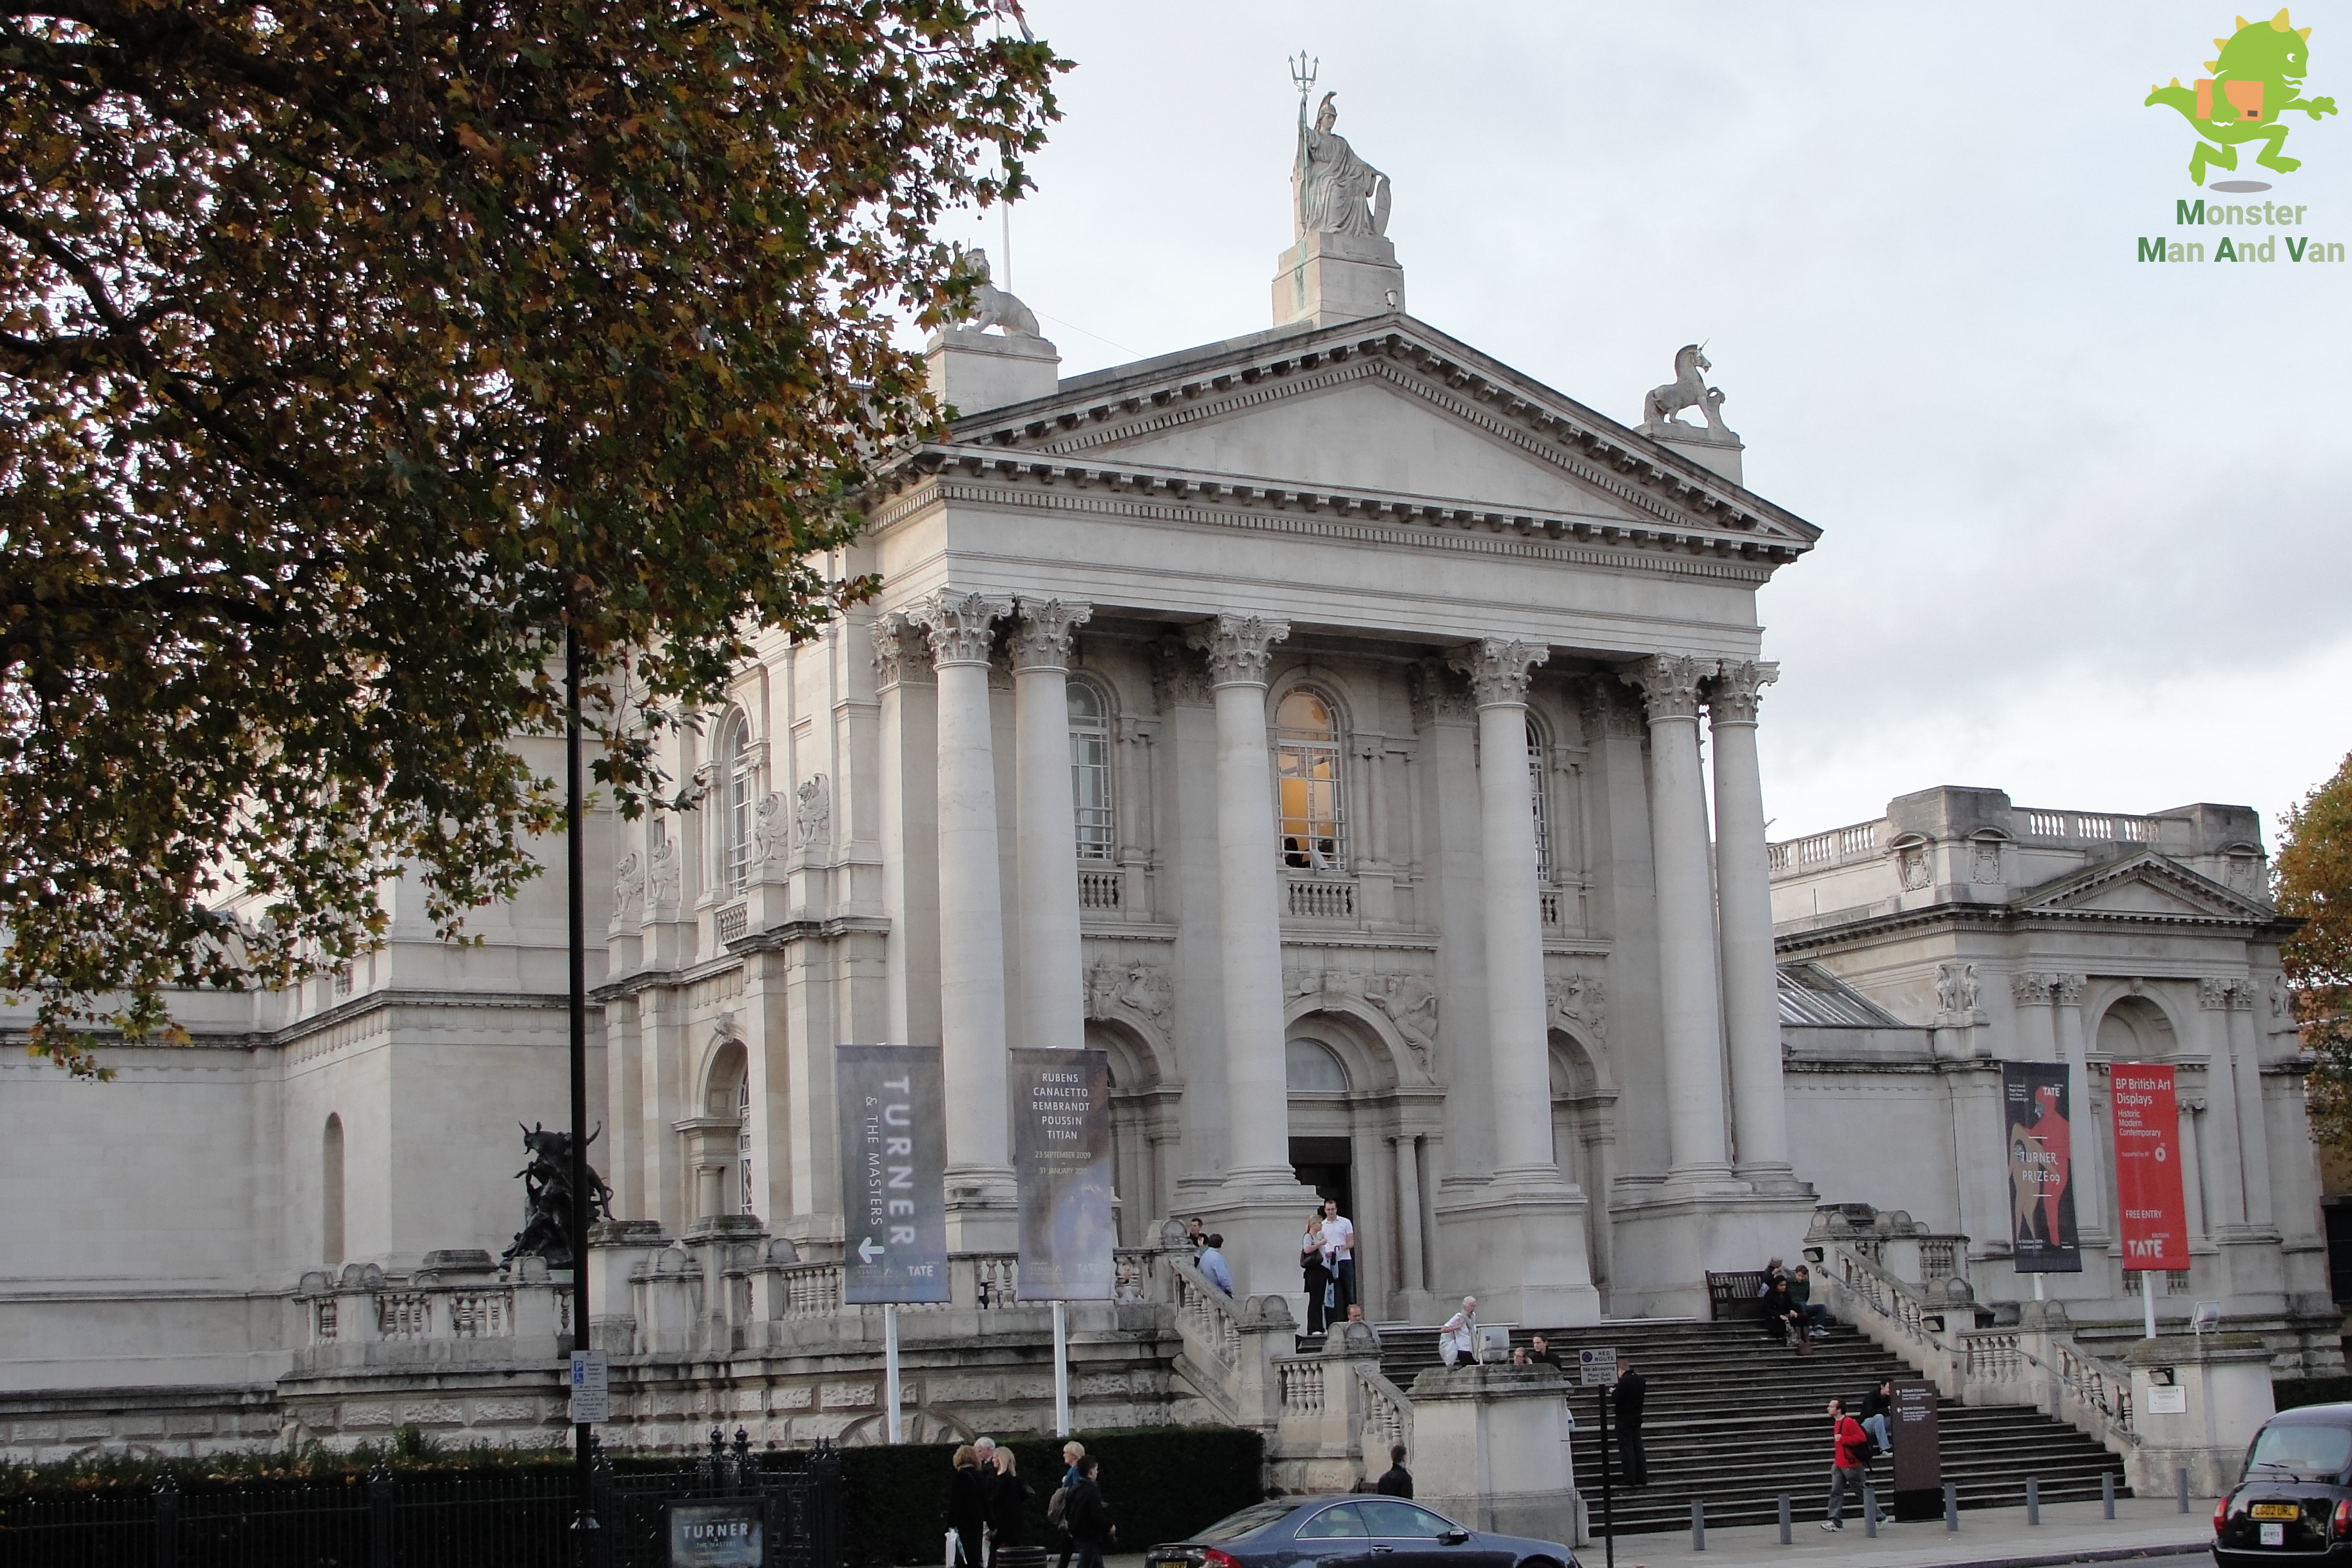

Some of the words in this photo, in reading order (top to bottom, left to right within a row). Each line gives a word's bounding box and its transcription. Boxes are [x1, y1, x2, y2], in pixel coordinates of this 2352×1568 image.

[1042, 1073, 1079, 1083] RUBENS
[2115, 1078, 2127, 1090] BP
[2129, 1079, 2155, 1090] British
[2157, 1079, 2171, 1090] Art
[1033, 1087, 1088, 1097] CANALETTO
[2043, 1087, 2060, 1097] TATE
[865, 1096, 878, 1106] &
[2117, 1093, 2153, 1107] Displays
[1032, 1101, 1090, 1112] REMBRANDT
[2118, 1110, 2141, 1118] Historic
[1042, 1115, 1082, 1125] POUSSIN
[2119, 1118, 2142, 1127] Modern
[866, 1115, 879, 1144] THE
[1047, 1130, 1077, 1140] TITIAN
[2119, 1128, 2161, 1137] Contemporary
[883, 1076, 916, 1246] TURNER
[2021, 1152, 2058, 1166] TURNER
[2022, 1170, 2049, 1183] PRIZE
[2050, 1173, 2060, 1185] 09
[868, 1152, 883, 1225] MASTERS
[2126, 1210, 2141, 1219] FREE
[2142, 1210, 2162, 1219] ENTRY
[2127, 1239, 2164, 1259] TATE
[907, 1266, 934, 1277] TATE
[683, 1523, 748, 1538] TURNER
